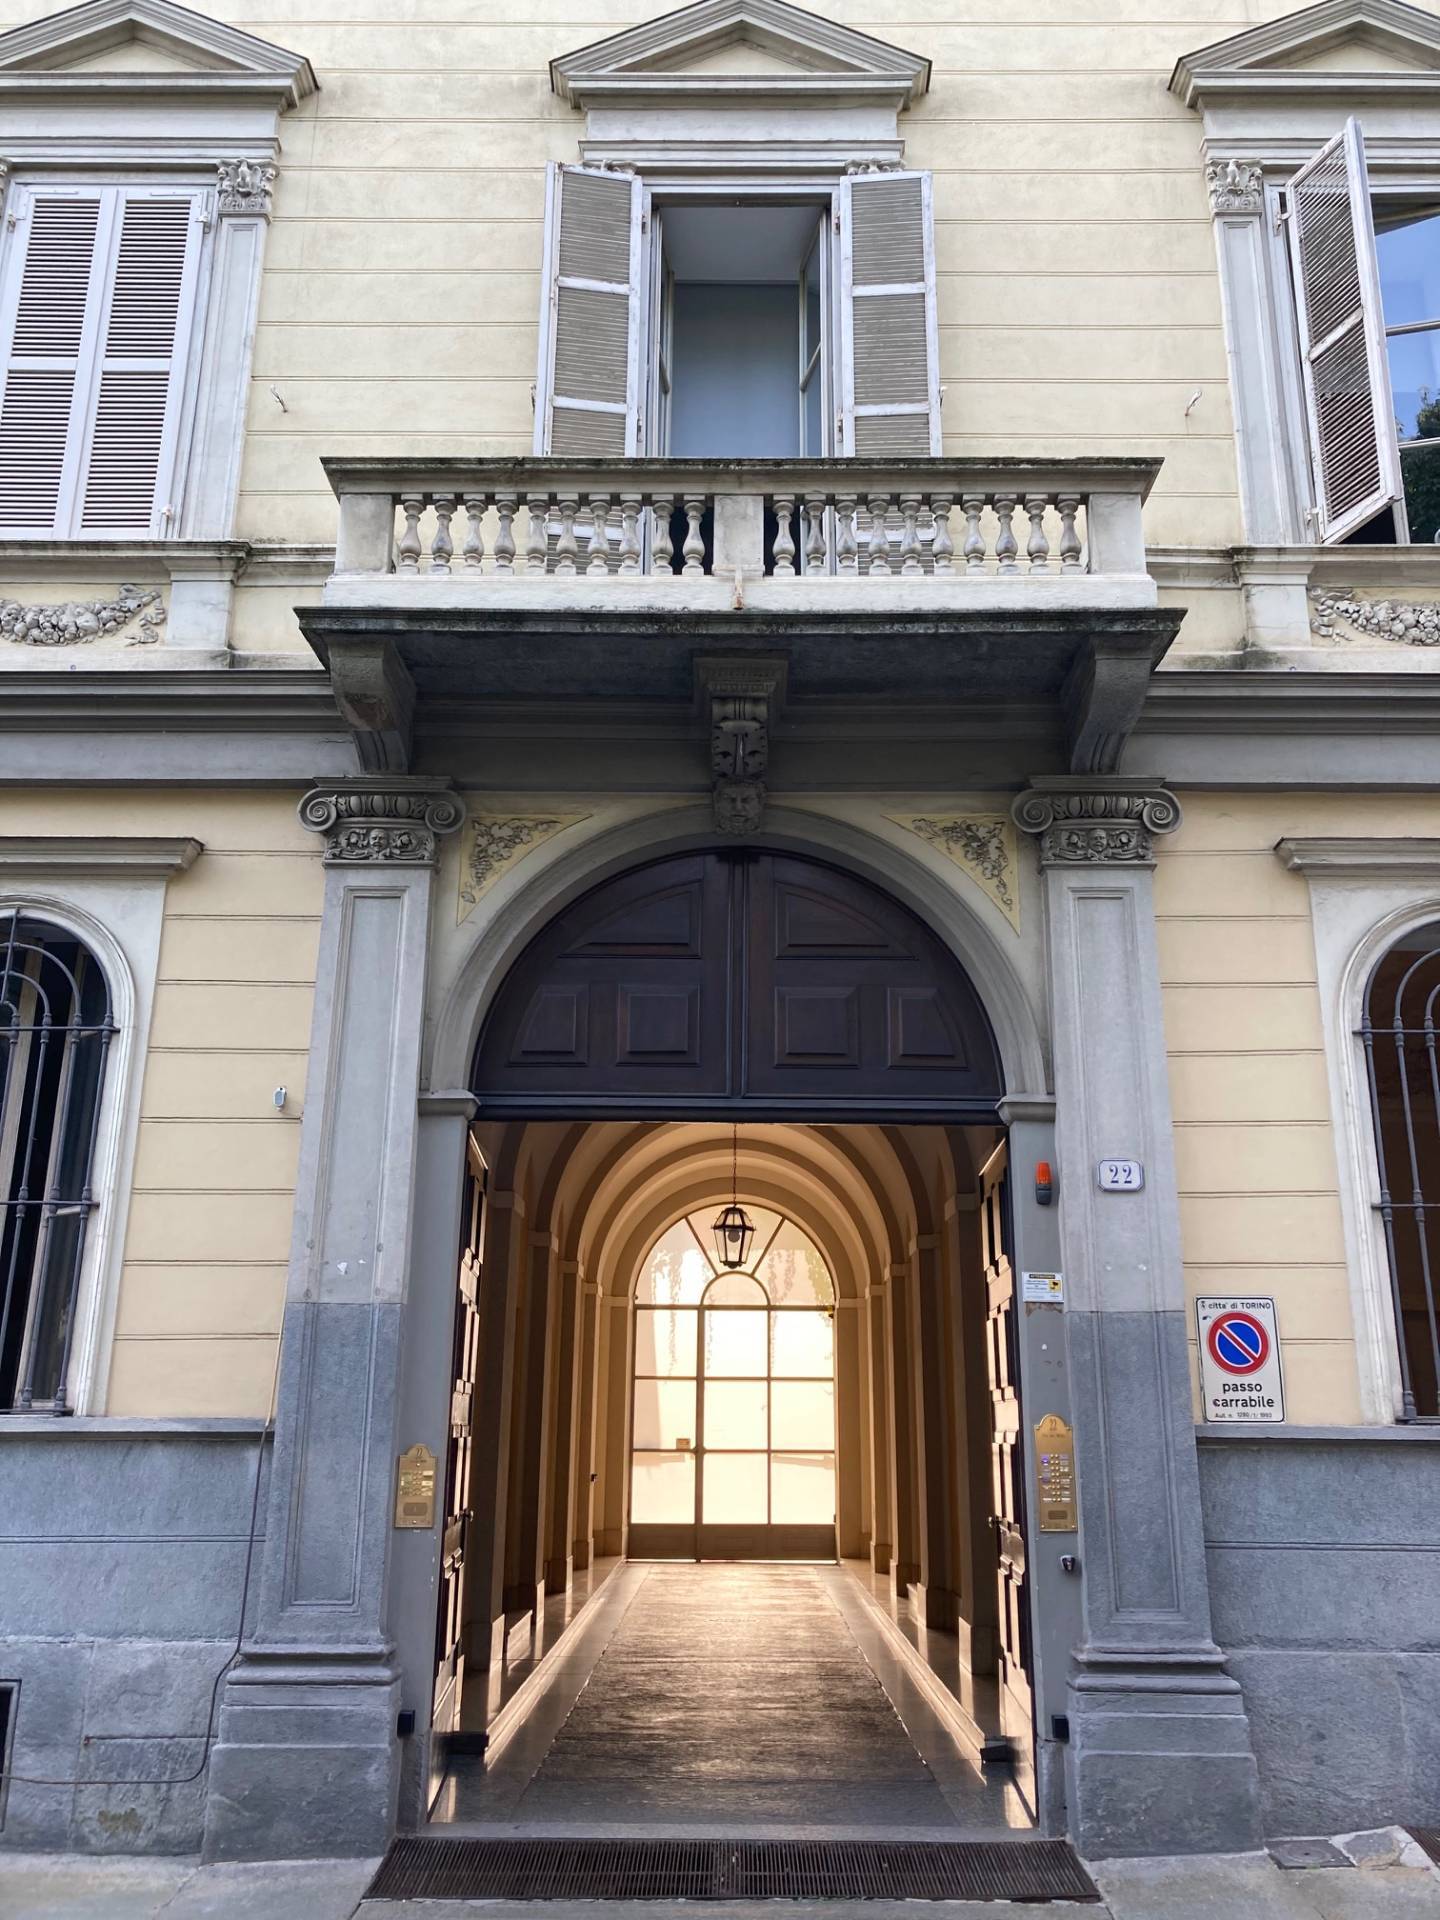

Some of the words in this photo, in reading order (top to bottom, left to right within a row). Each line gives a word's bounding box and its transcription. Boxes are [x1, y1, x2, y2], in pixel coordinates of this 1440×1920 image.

[1109, 1164, 1133, 1184] 22
[1230, 1301, 1238, 1309] di
[1222, 1382, 1263, 1394] passo
[1213, 1396, 1275, 1408] carrabile
